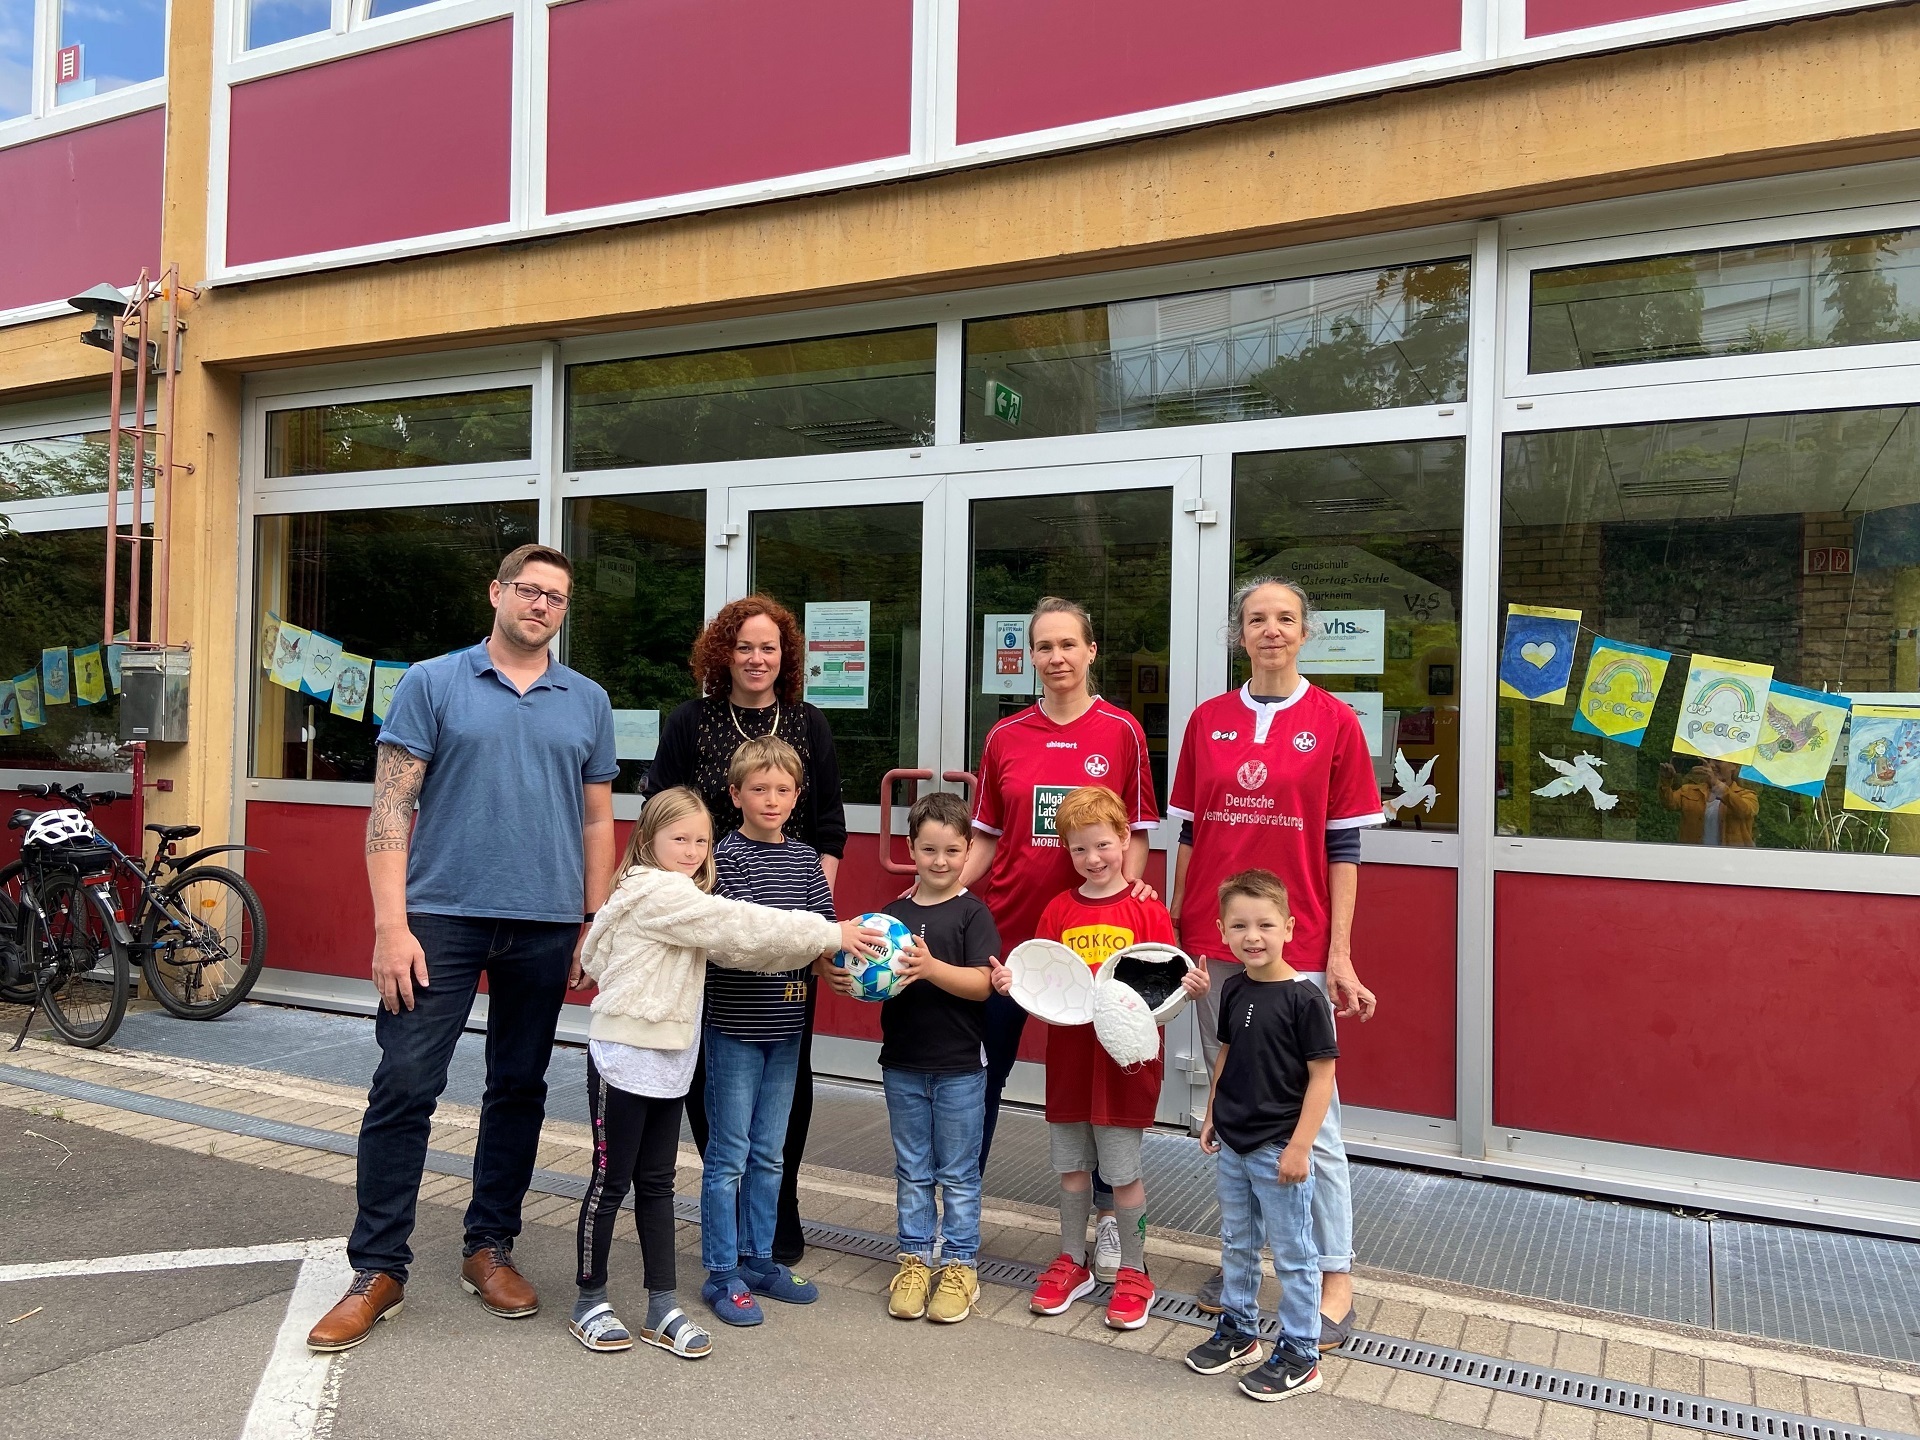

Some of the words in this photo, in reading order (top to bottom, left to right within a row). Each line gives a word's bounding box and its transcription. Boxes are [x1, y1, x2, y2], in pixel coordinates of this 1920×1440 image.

[1291, 560, 1349, 571] Grundschule
[1323, 618, 1356, 634] vhs
[1588, 698, 1644, 722] peace
[1687, 720, 1751, 743] peace
[1046, 741, 1077, 749] uhlsport
[1038, 792, 1066, 807] Allgä
[1225, 793, 1275, 809] Deutsche
[1038, 805, 1058, 817] Lats
[1031, 837, 1061, 848] MOBIL
